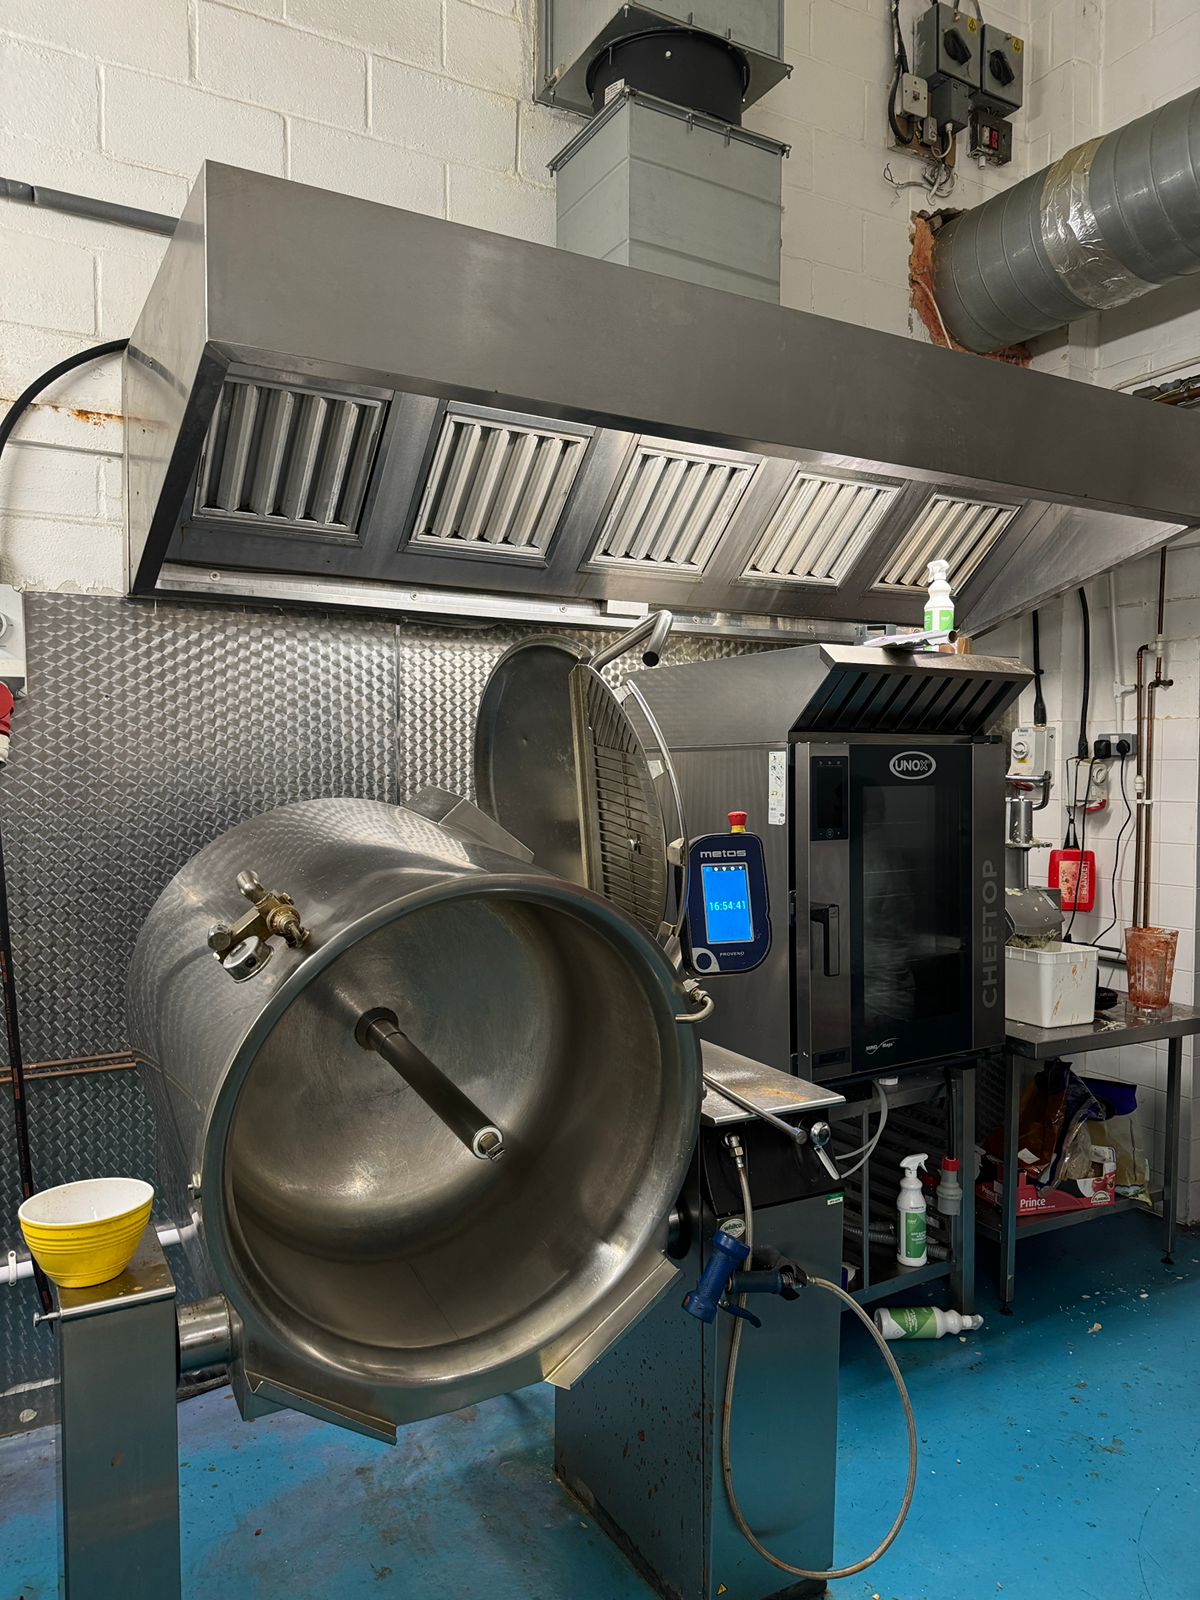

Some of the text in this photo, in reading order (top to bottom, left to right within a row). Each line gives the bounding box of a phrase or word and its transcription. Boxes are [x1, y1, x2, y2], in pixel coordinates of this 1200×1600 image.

[700, 850, 747, 858] metos
[709, 901, 746, 911] 16:54:41
[982, 860, 997, 1008] CHEFTOP
[1020, 1197, 1046, 1208] Prince
